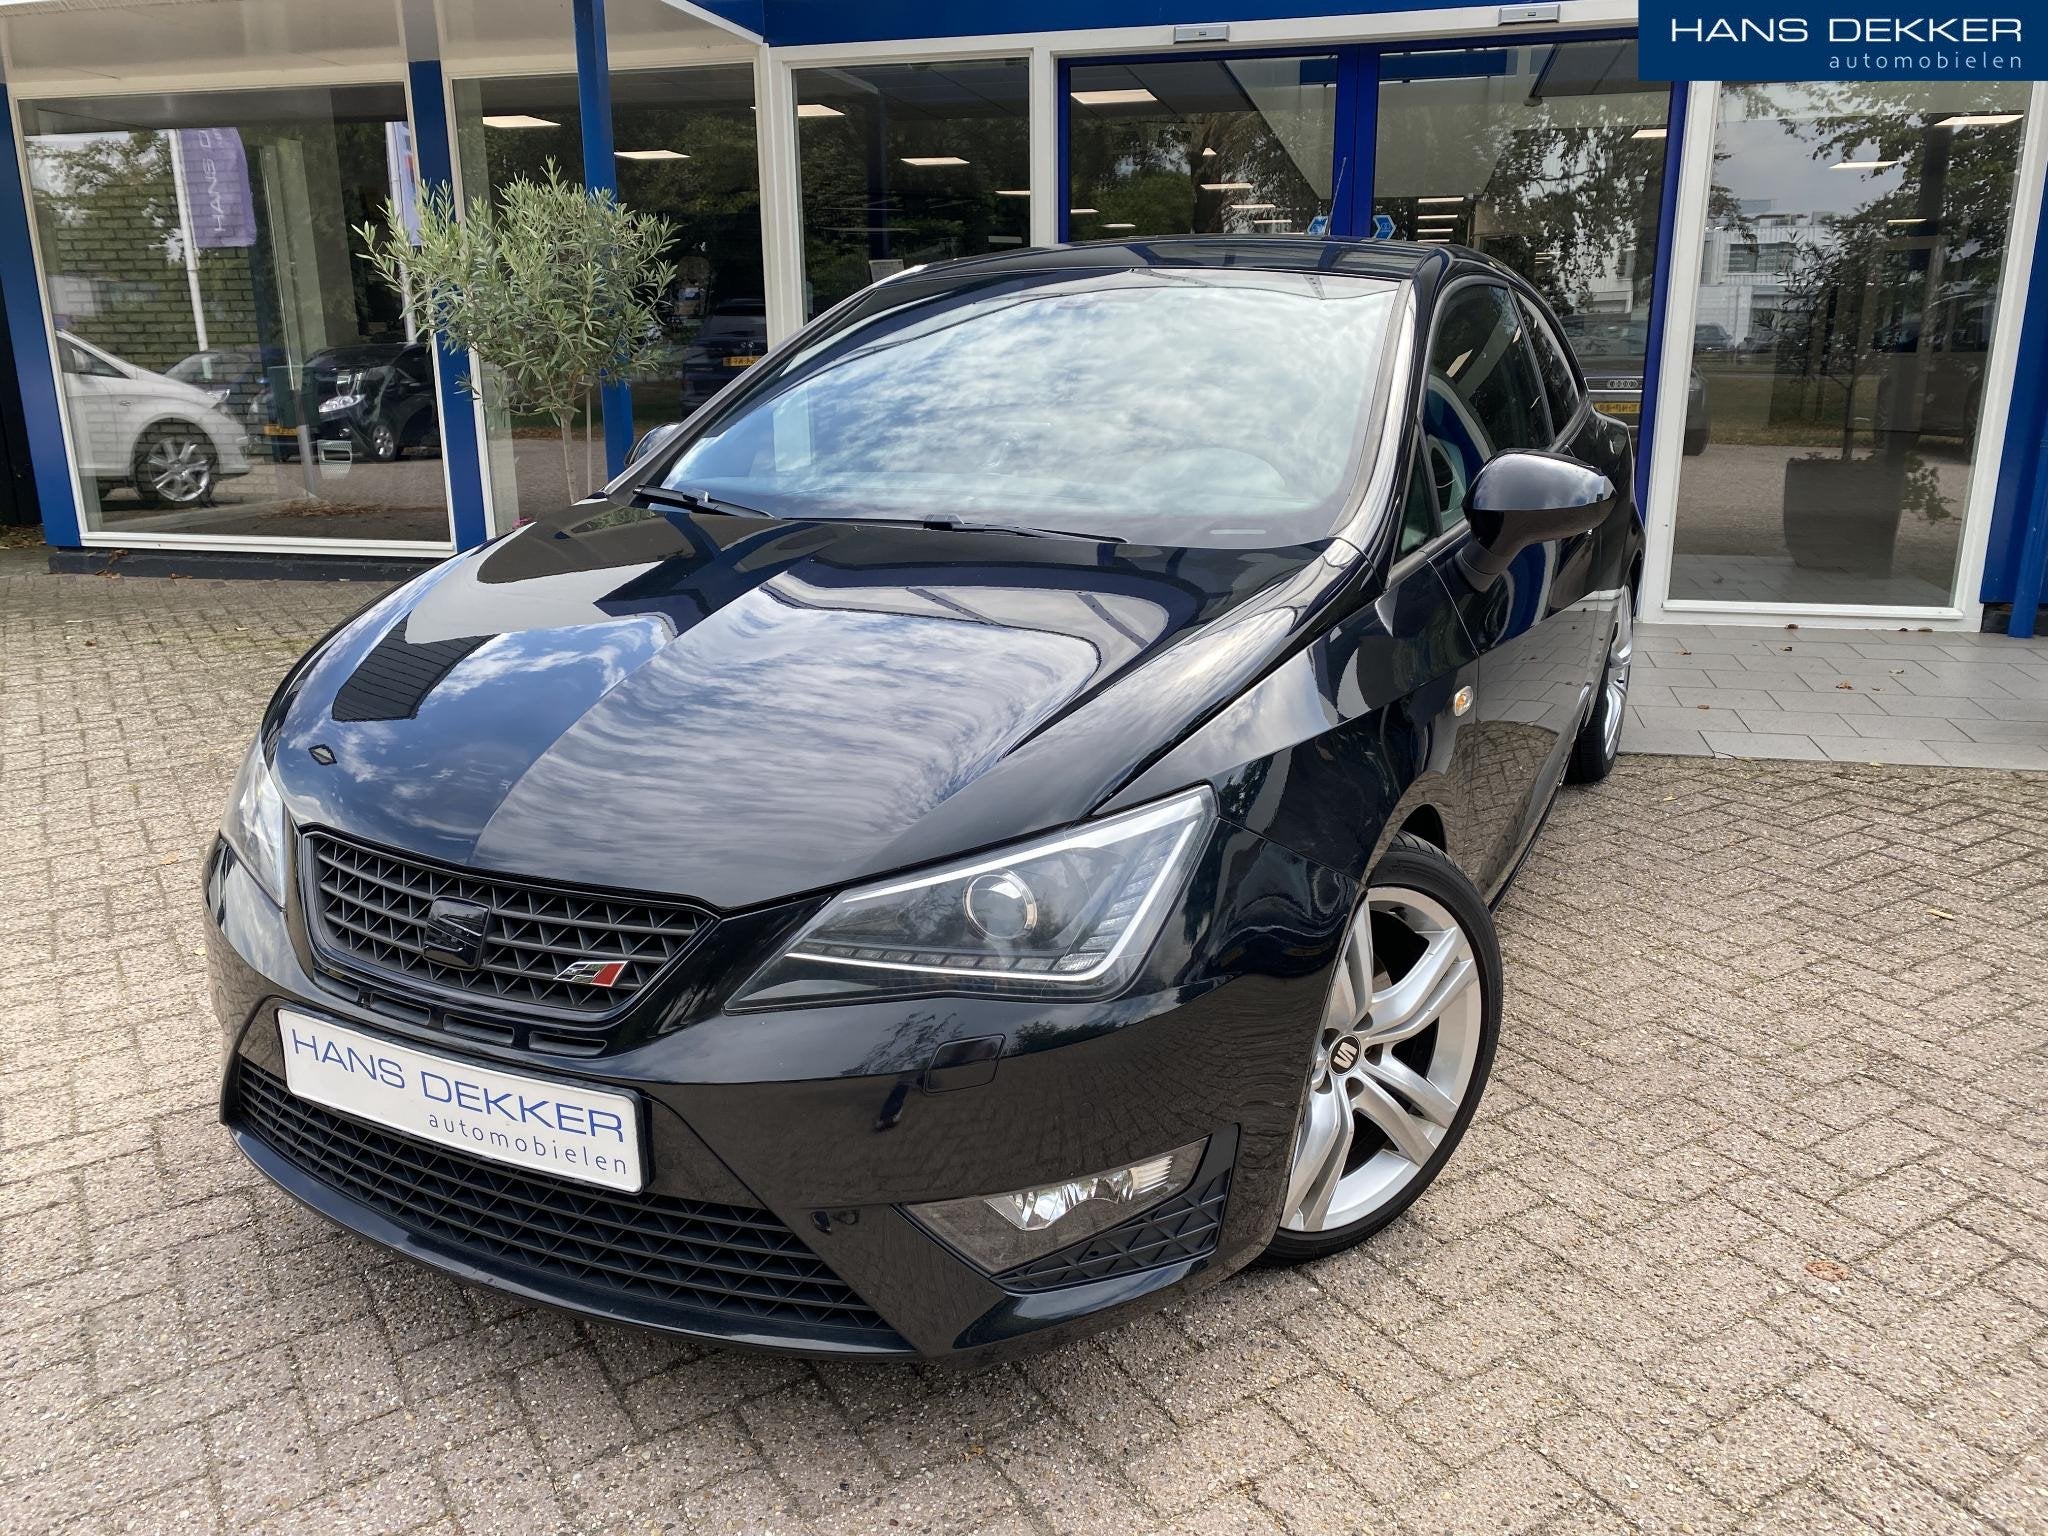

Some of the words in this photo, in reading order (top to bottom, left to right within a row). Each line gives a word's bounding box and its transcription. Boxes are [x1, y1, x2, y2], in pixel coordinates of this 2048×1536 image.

[291, 1028, 406, 1089] HANS
[420, 1070, 625, 1143] DEKKER
[428, 1112, 627, 1175] automobielen
